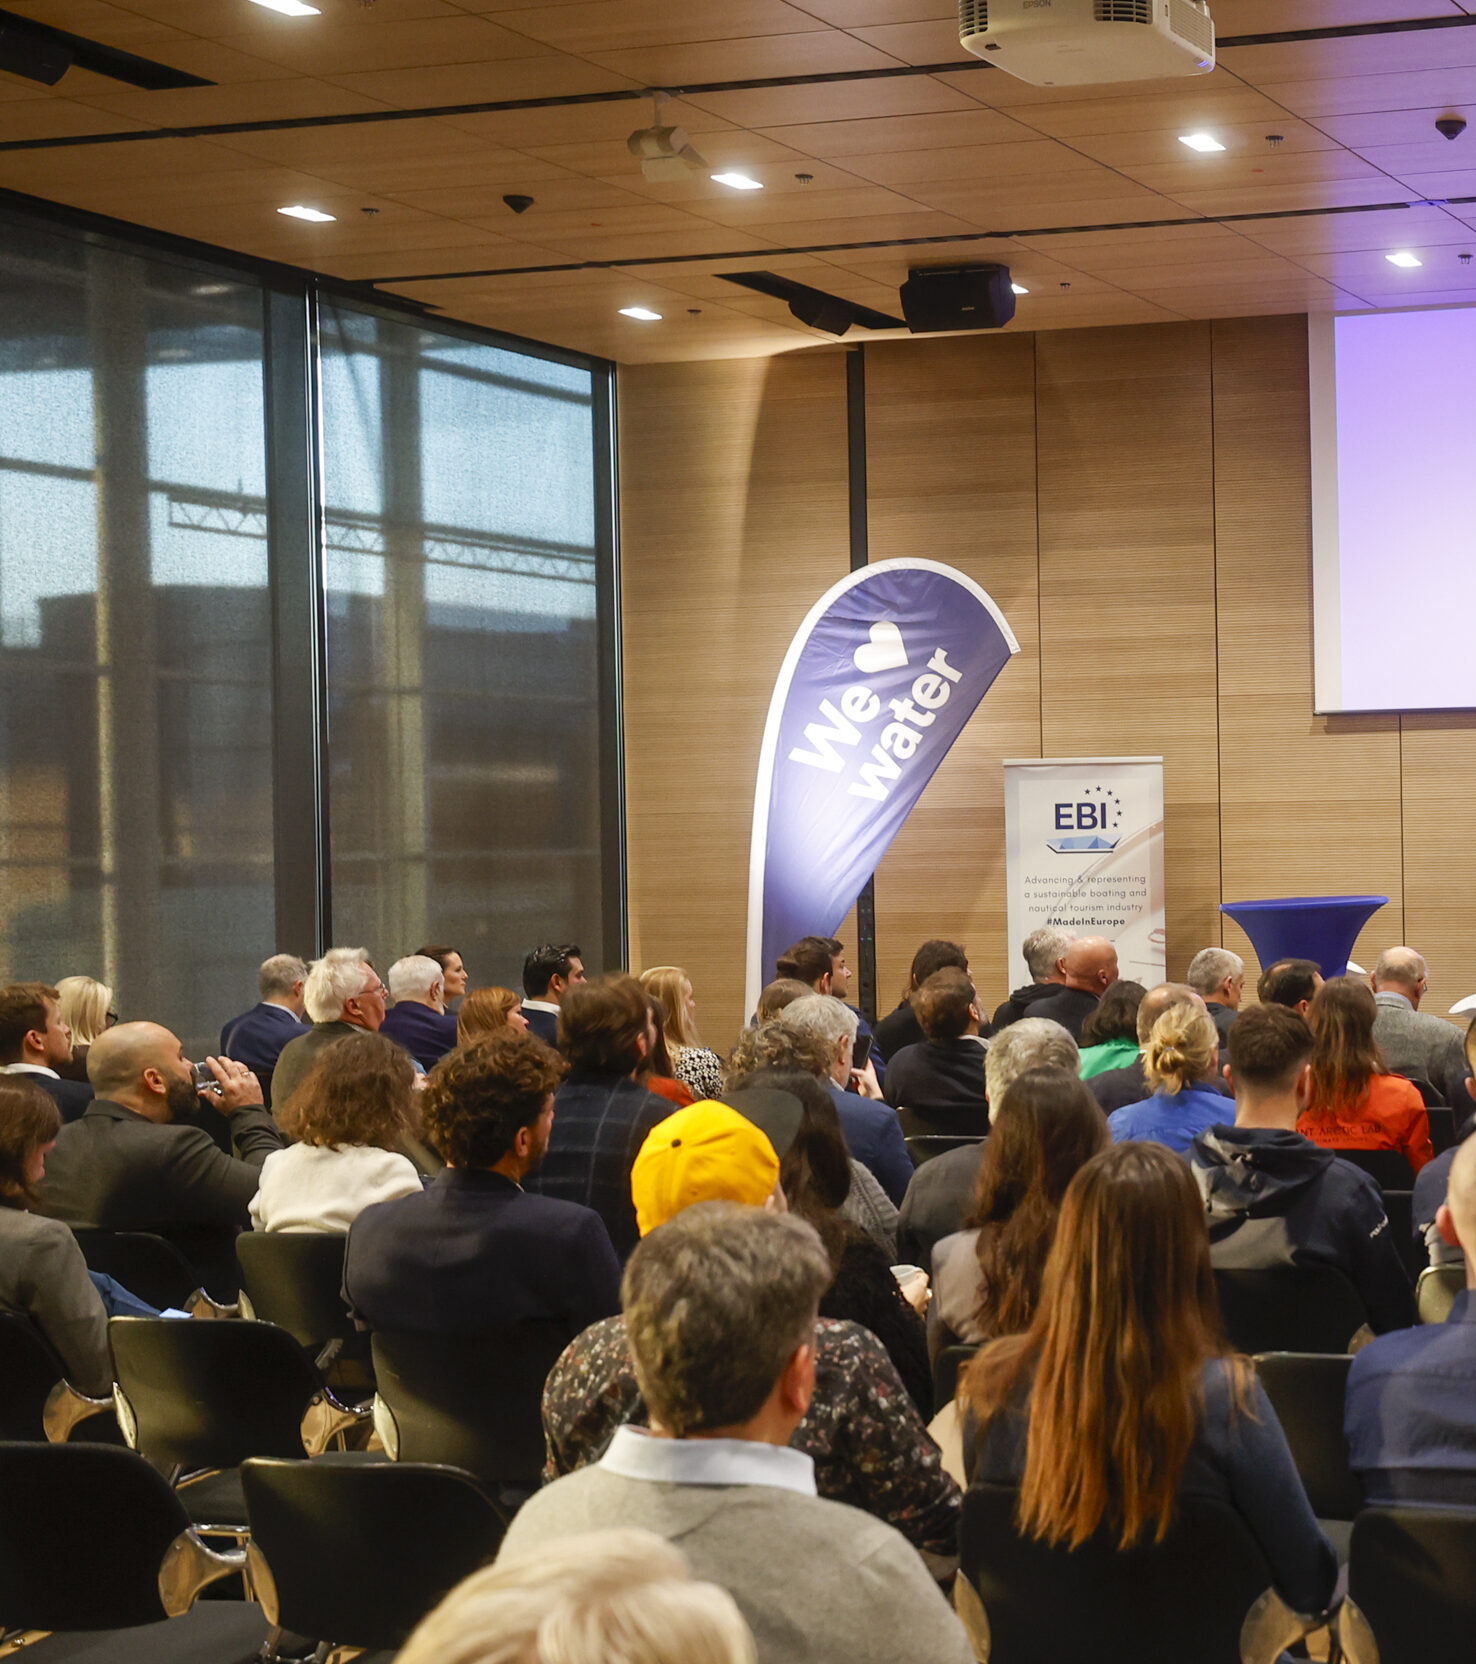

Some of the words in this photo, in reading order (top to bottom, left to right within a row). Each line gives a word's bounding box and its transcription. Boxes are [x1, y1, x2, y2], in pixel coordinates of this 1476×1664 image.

[788, 685, 881, 774] We
[847, 647, 963, 802] water
[1054, 802, 1107, 830] EBI
[1024, 875, 1074, 886] Advancing
[1087, 875, 1146, 885] representing
[1033, 888, 1087, 898] sustainable
[1090, 888, 1126, 899] boating
[1129, 888, 1147, 897] and
[1028, 903, 1067, 913] nautical
[1070, 904, 1104, 912] tourism
[1107, 903, 1144, 913] industry
[1046, 917, 1126, 927] #MadeInEurope
